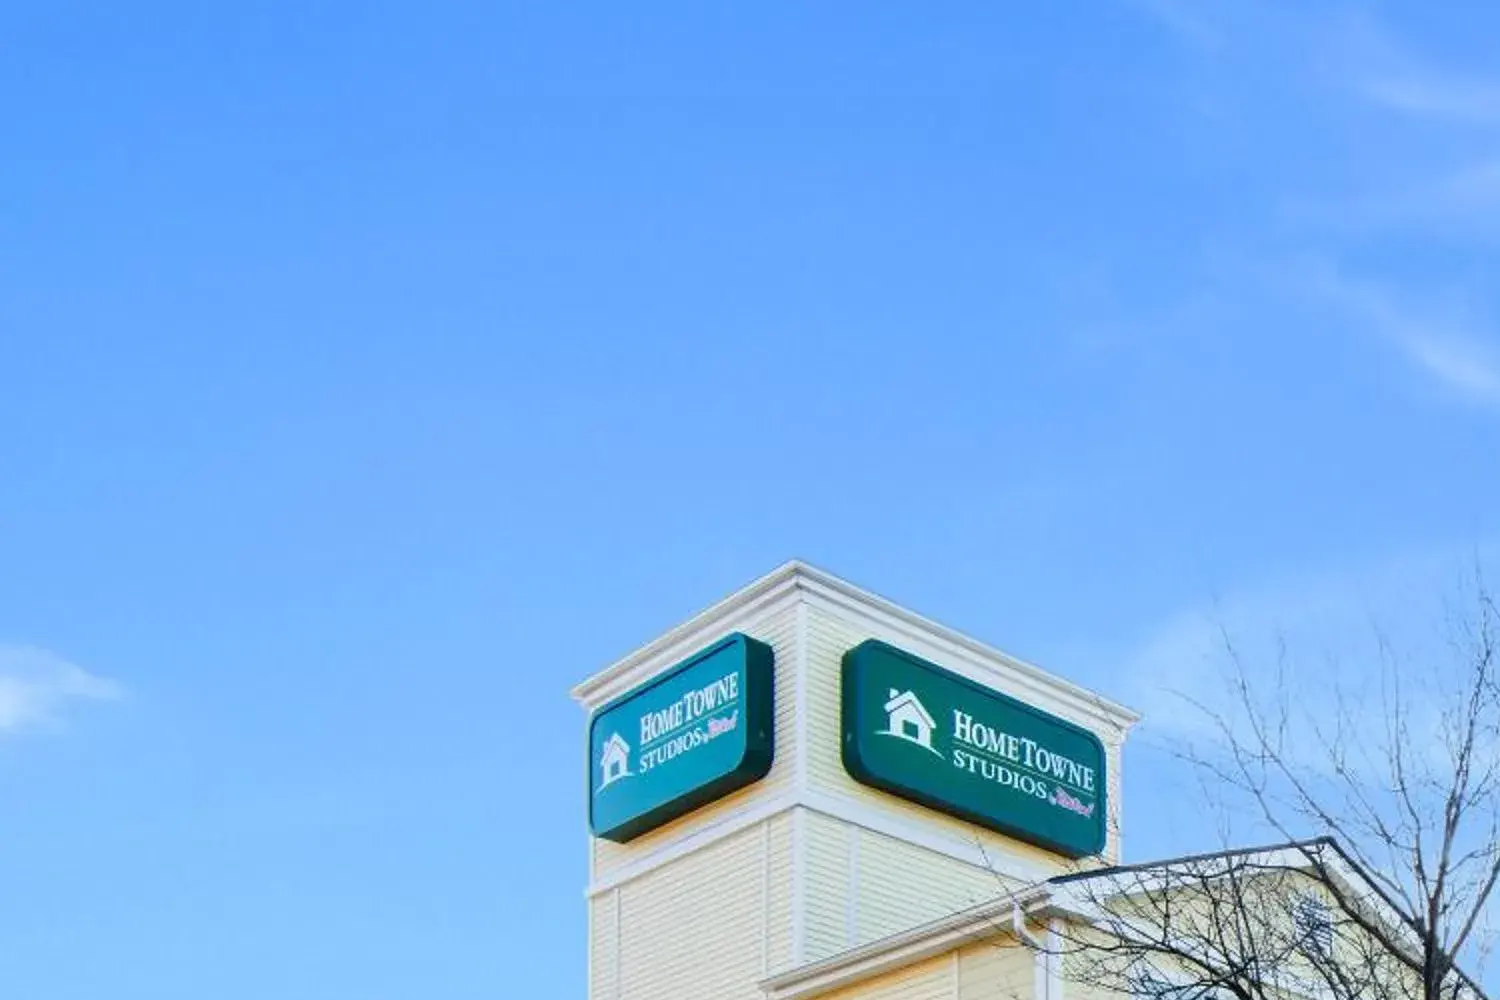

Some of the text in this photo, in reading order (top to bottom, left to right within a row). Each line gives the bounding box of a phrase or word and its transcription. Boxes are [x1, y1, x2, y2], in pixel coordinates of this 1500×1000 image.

[639, 671, 739, 745] HOMETOWNE
[639, 727, 701, 773] STUDIOS
[953, 709, 1095, 791] HOMETOWNE
[953, 749, 1047, 799] STUDIOS
